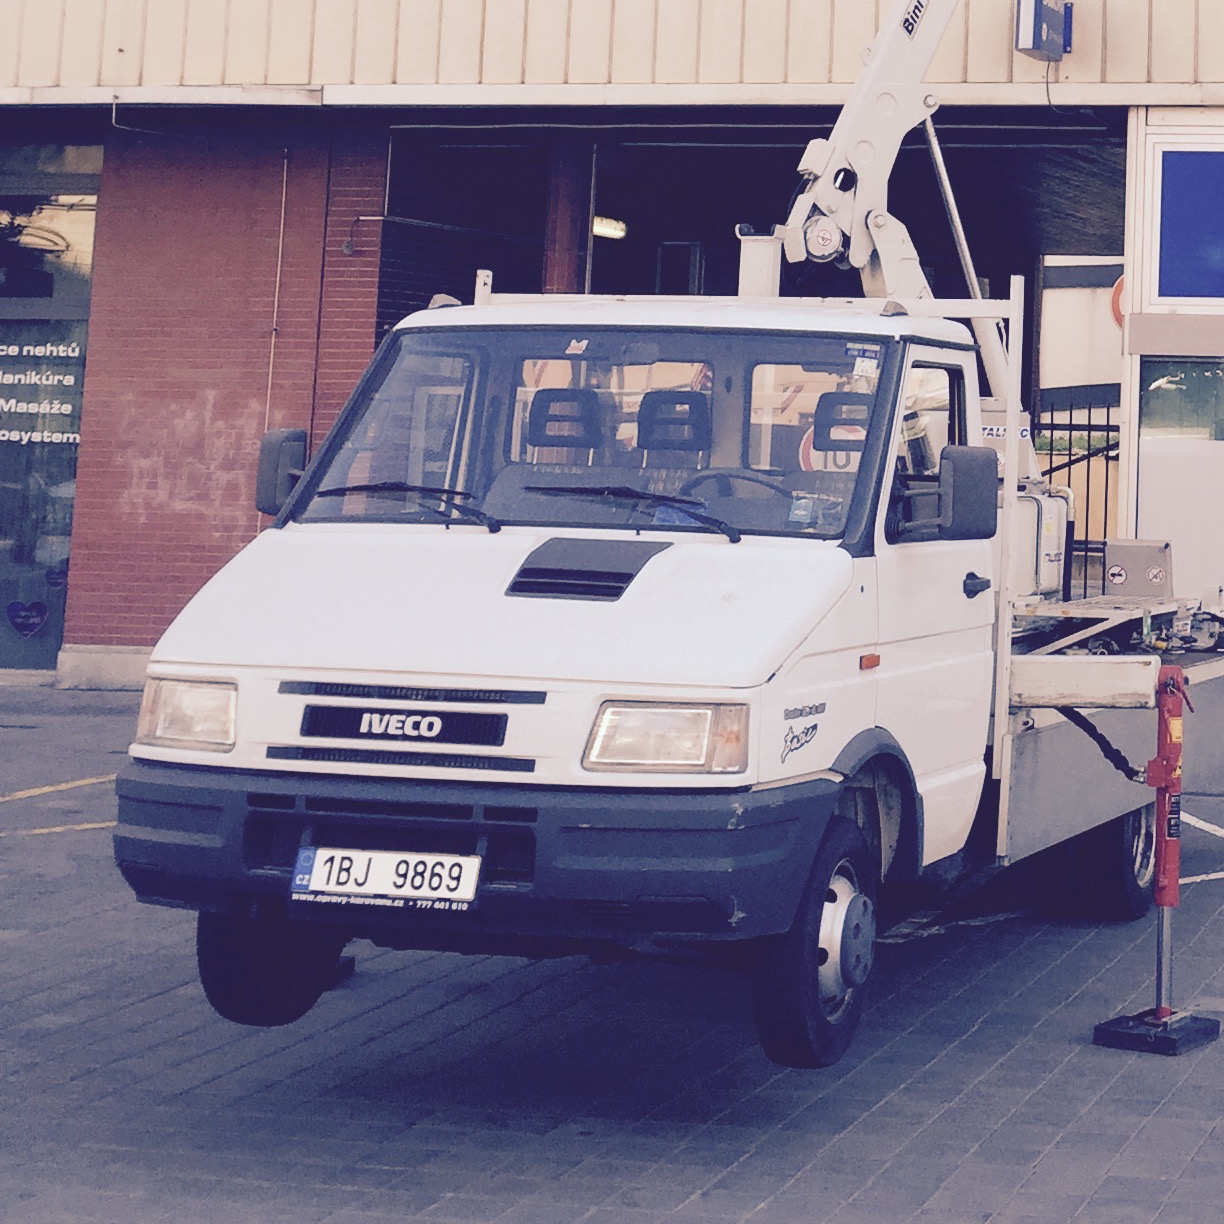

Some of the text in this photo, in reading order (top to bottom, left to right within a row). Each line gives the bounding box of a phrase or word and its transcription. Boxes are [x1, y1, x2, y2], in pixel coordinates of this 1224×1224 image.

[22, 342, 80, 357] nehtů
[0, 370, 75, 386] anikúra
[0, 398, 73, 414] Masáže
[360, 713, 442, 737] IVECO
[295, 874, 310, 885] CZ
[322, 855, 463, 893] 1BJ 9869
[416, 900, 434, 909] 777
